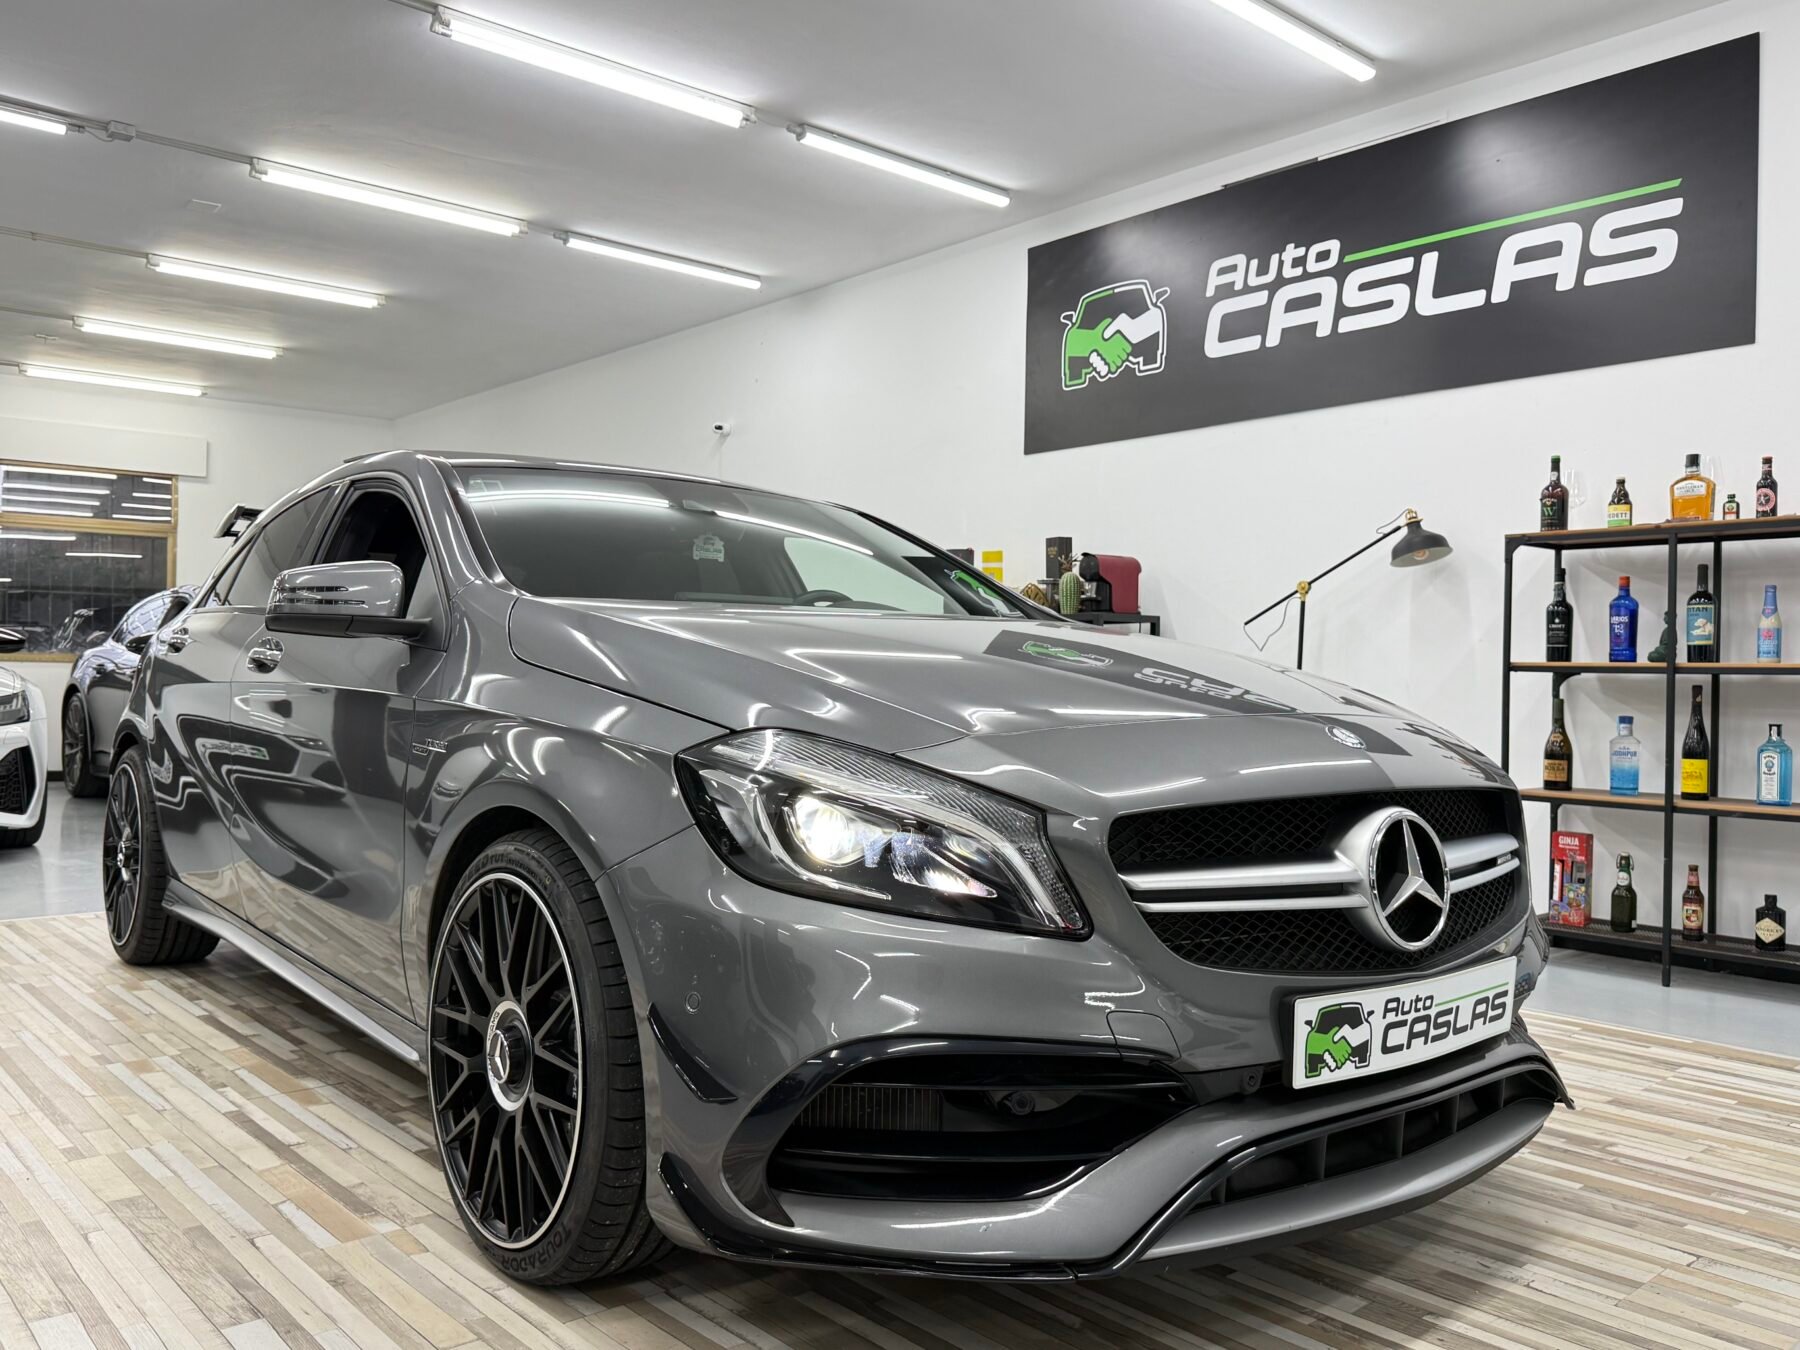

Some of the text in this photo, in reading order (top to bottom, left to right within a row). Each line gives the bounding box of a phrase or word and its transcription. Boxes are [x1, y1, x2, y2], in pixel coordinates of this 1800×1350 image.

[1203, 197, 1684, 358] CASLAS
[1205, 238, 1341, 297] Auto
[1558, 835, 1580, 846] GINJA
[1380, 989, 1509, 1055] CASLAS
[1382, 994, 1434, 1020] Auto
